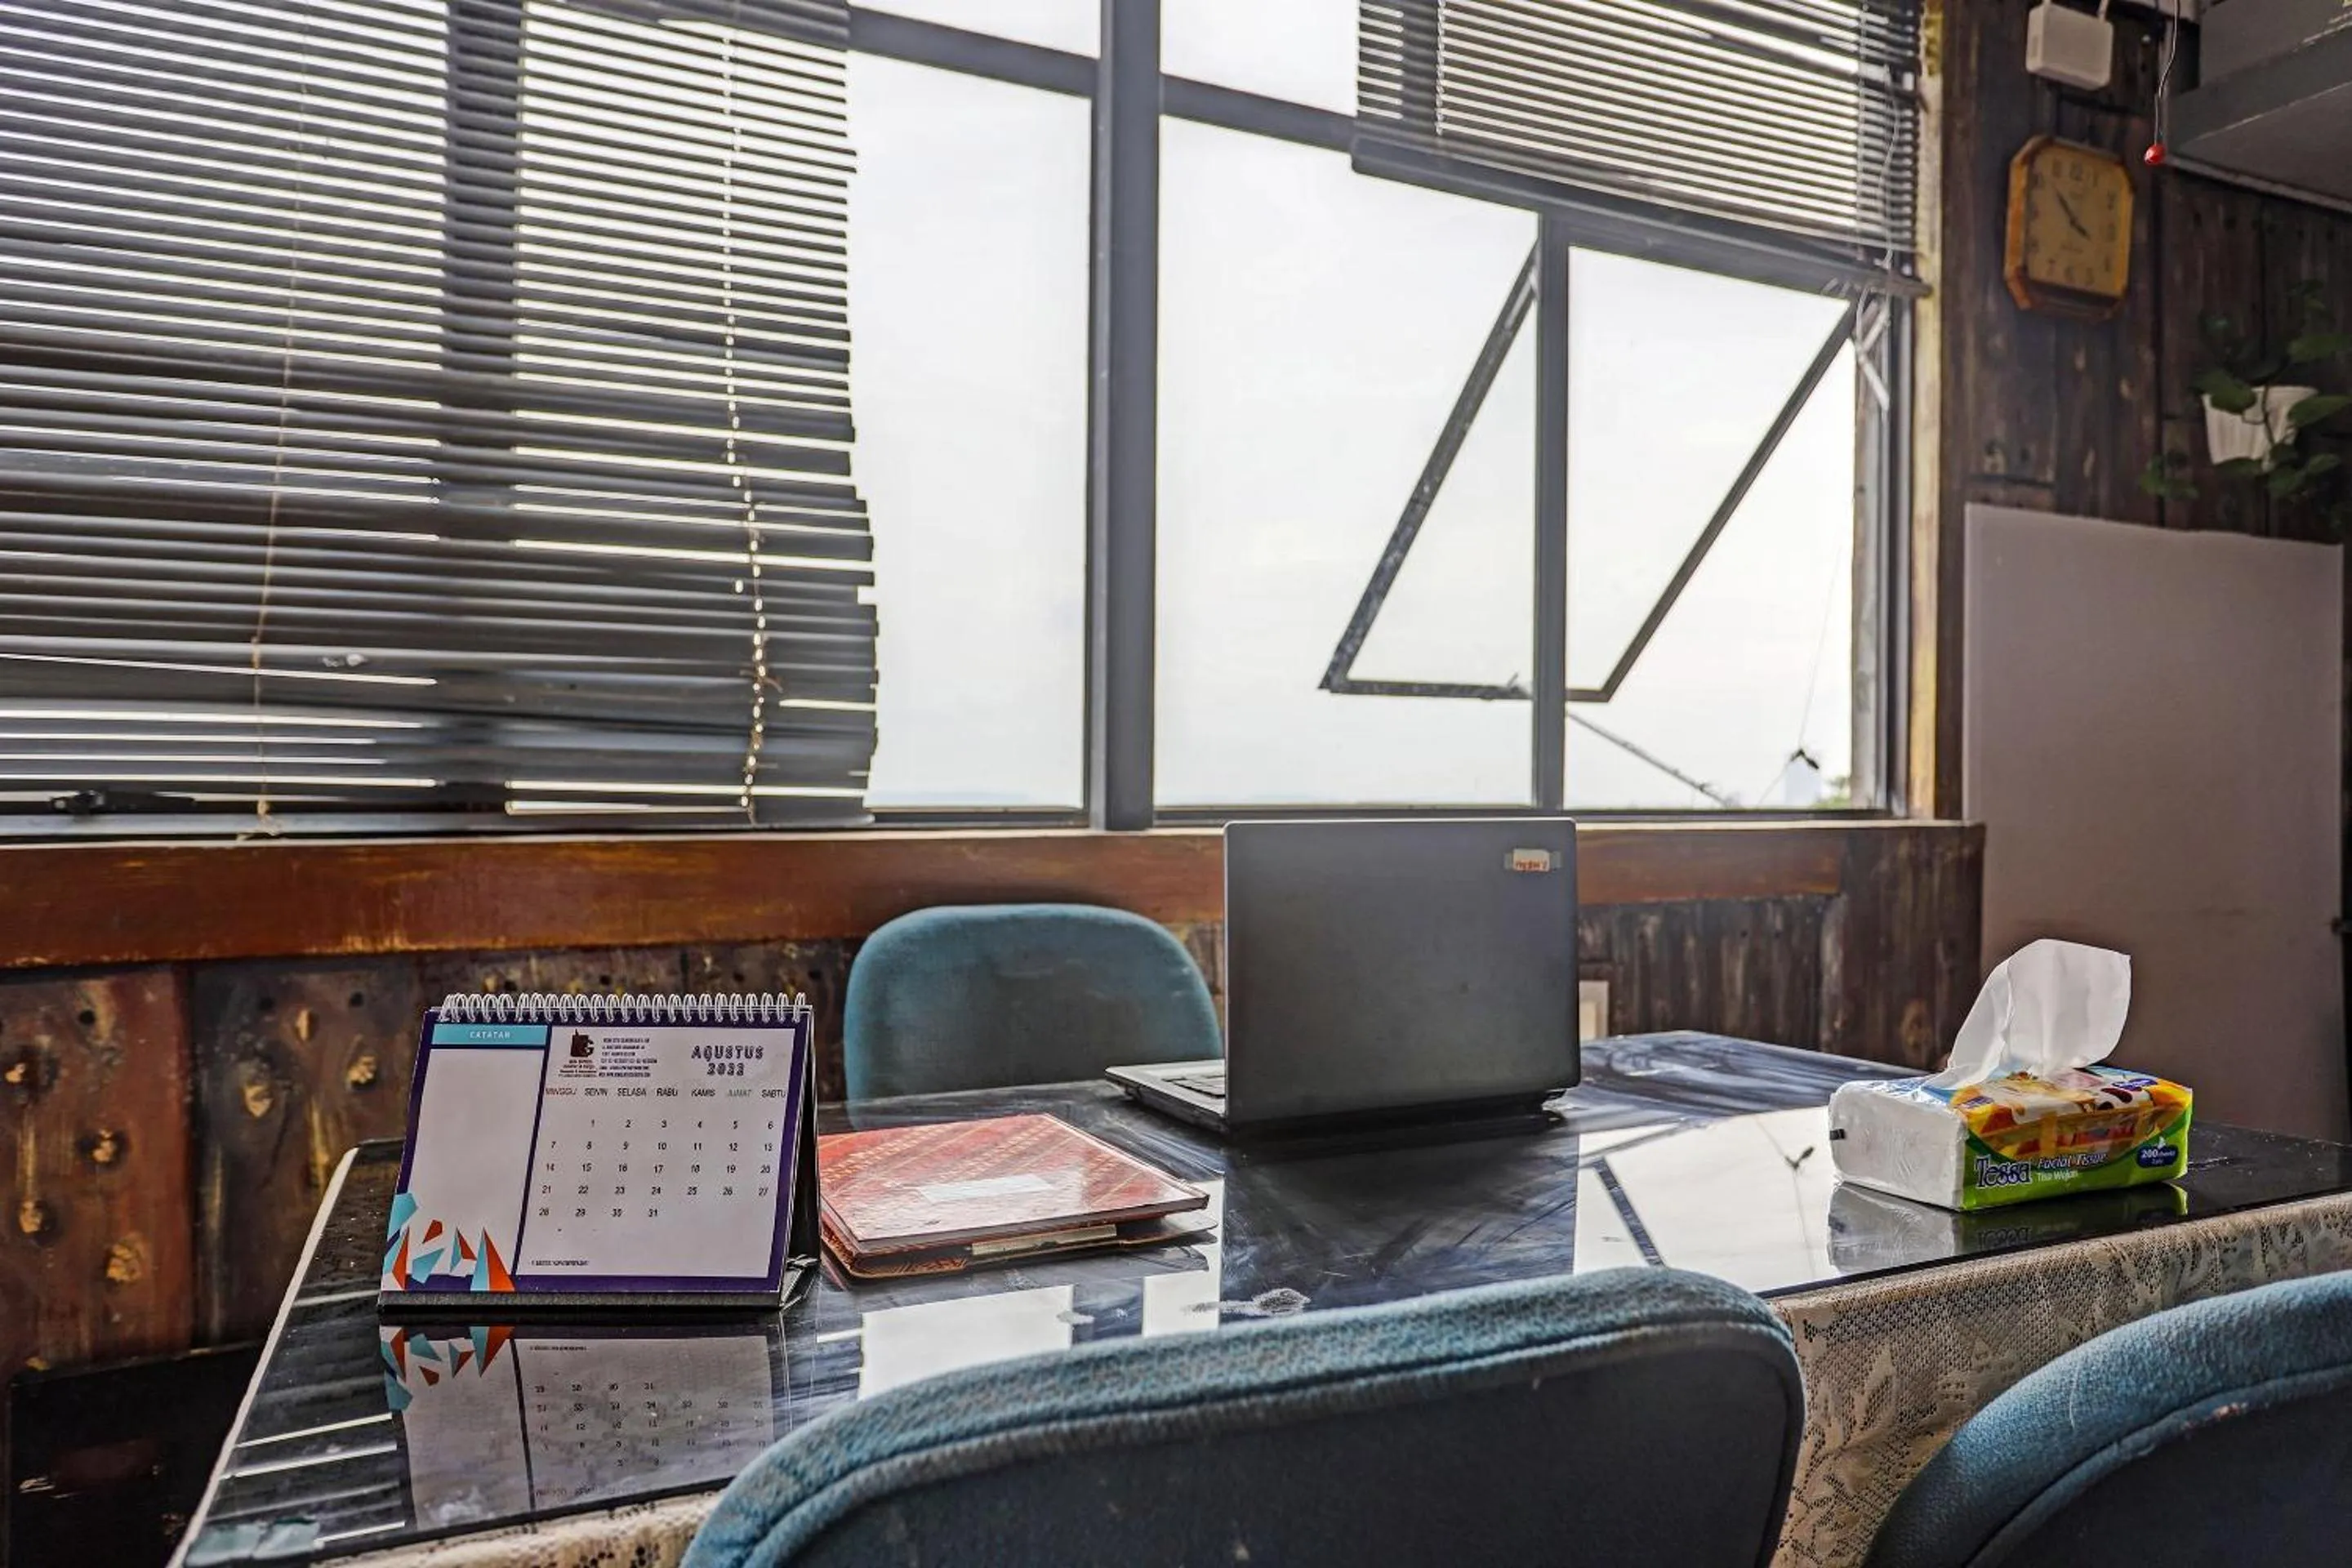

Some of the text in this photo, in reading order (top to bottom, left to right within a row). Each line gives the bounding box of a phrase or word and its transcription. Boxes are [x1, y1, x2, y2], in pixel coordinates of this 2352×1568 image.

[470, 1031, 510, 1040] CATATAN
[691, 1045, 764, 1062] AGUSTUS
[617, 1087, 647, 1098] SELASA
[656, 1088, 679, 1098] RABU
[691, 1088, 716, 1098] KAMIS
[761, 1089, 786, 1098] SABTU
[590, 1119, 774, 1130] 1 2 3 4 5 6
[551, 1140, 557, 1149] 7
[623, 1141, 629, 1151] 9
[657, 1142, 667, 1151] 10
[693, 1143, 702, 1151] 11
[728, 1142, 738, 1152] 12
[2140, 1148, 2158, 1159] 200
[2038, 1152, 2107, 1169] Facial Tissue
[582, 1162, 592, 1172] 15
[654, 1164, 664, 1174] 17
[726, 1164, 737, 1174] 19
[760, 1165, 771, 1174] 20
[1975, 1154, 2032, 1189] Tessa
[541, 1184, 768, 1196] 21 22 23 24 25 26 27
[648, 1208, 658, 1218] 31
